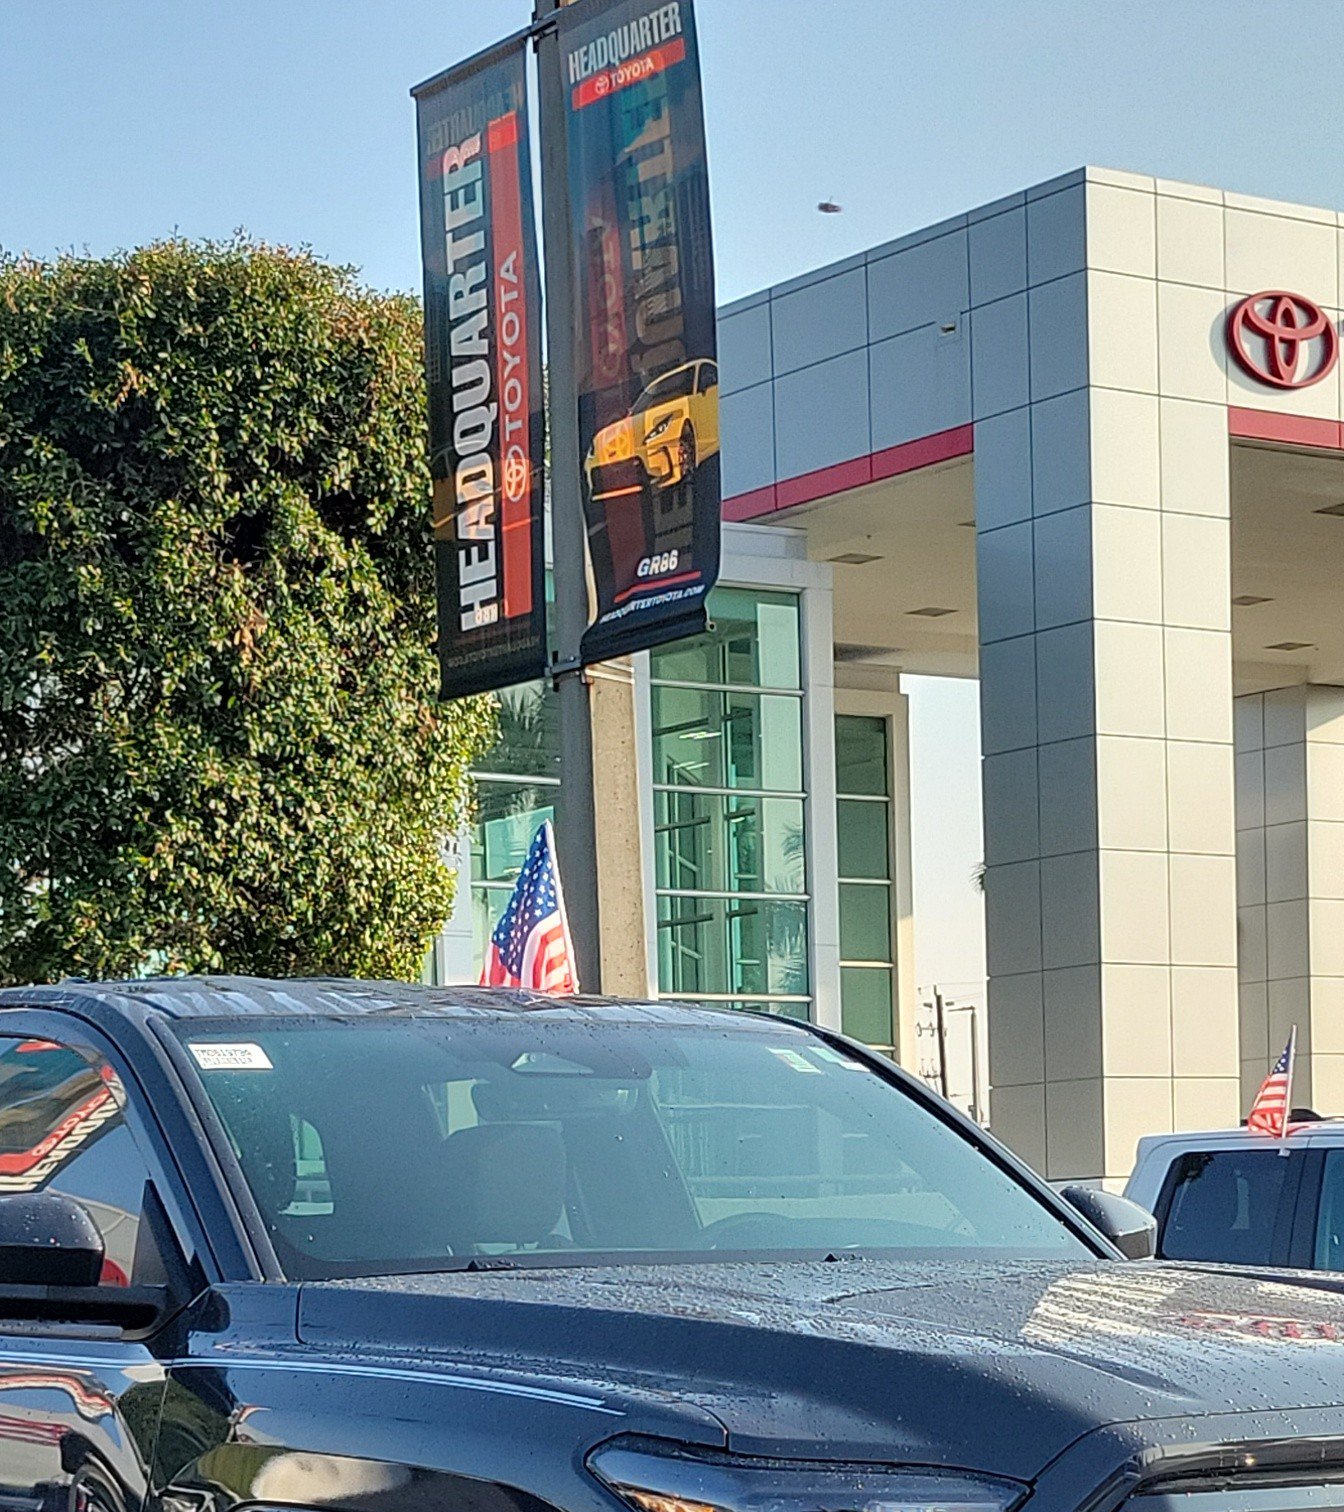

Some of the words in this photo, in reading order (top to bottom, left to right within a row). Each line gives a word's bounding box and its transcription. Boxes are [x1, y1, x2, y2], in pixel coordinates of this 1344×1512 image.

[567, 1, 683, 86] HEADQUARTER
[611, 57, 655, 87] TOYOTA
[443, 131, 499, 632] HEADQUARTER
[499, 250, 526, 442] TOYOTA
[637, 549, 679, 578] GR86
